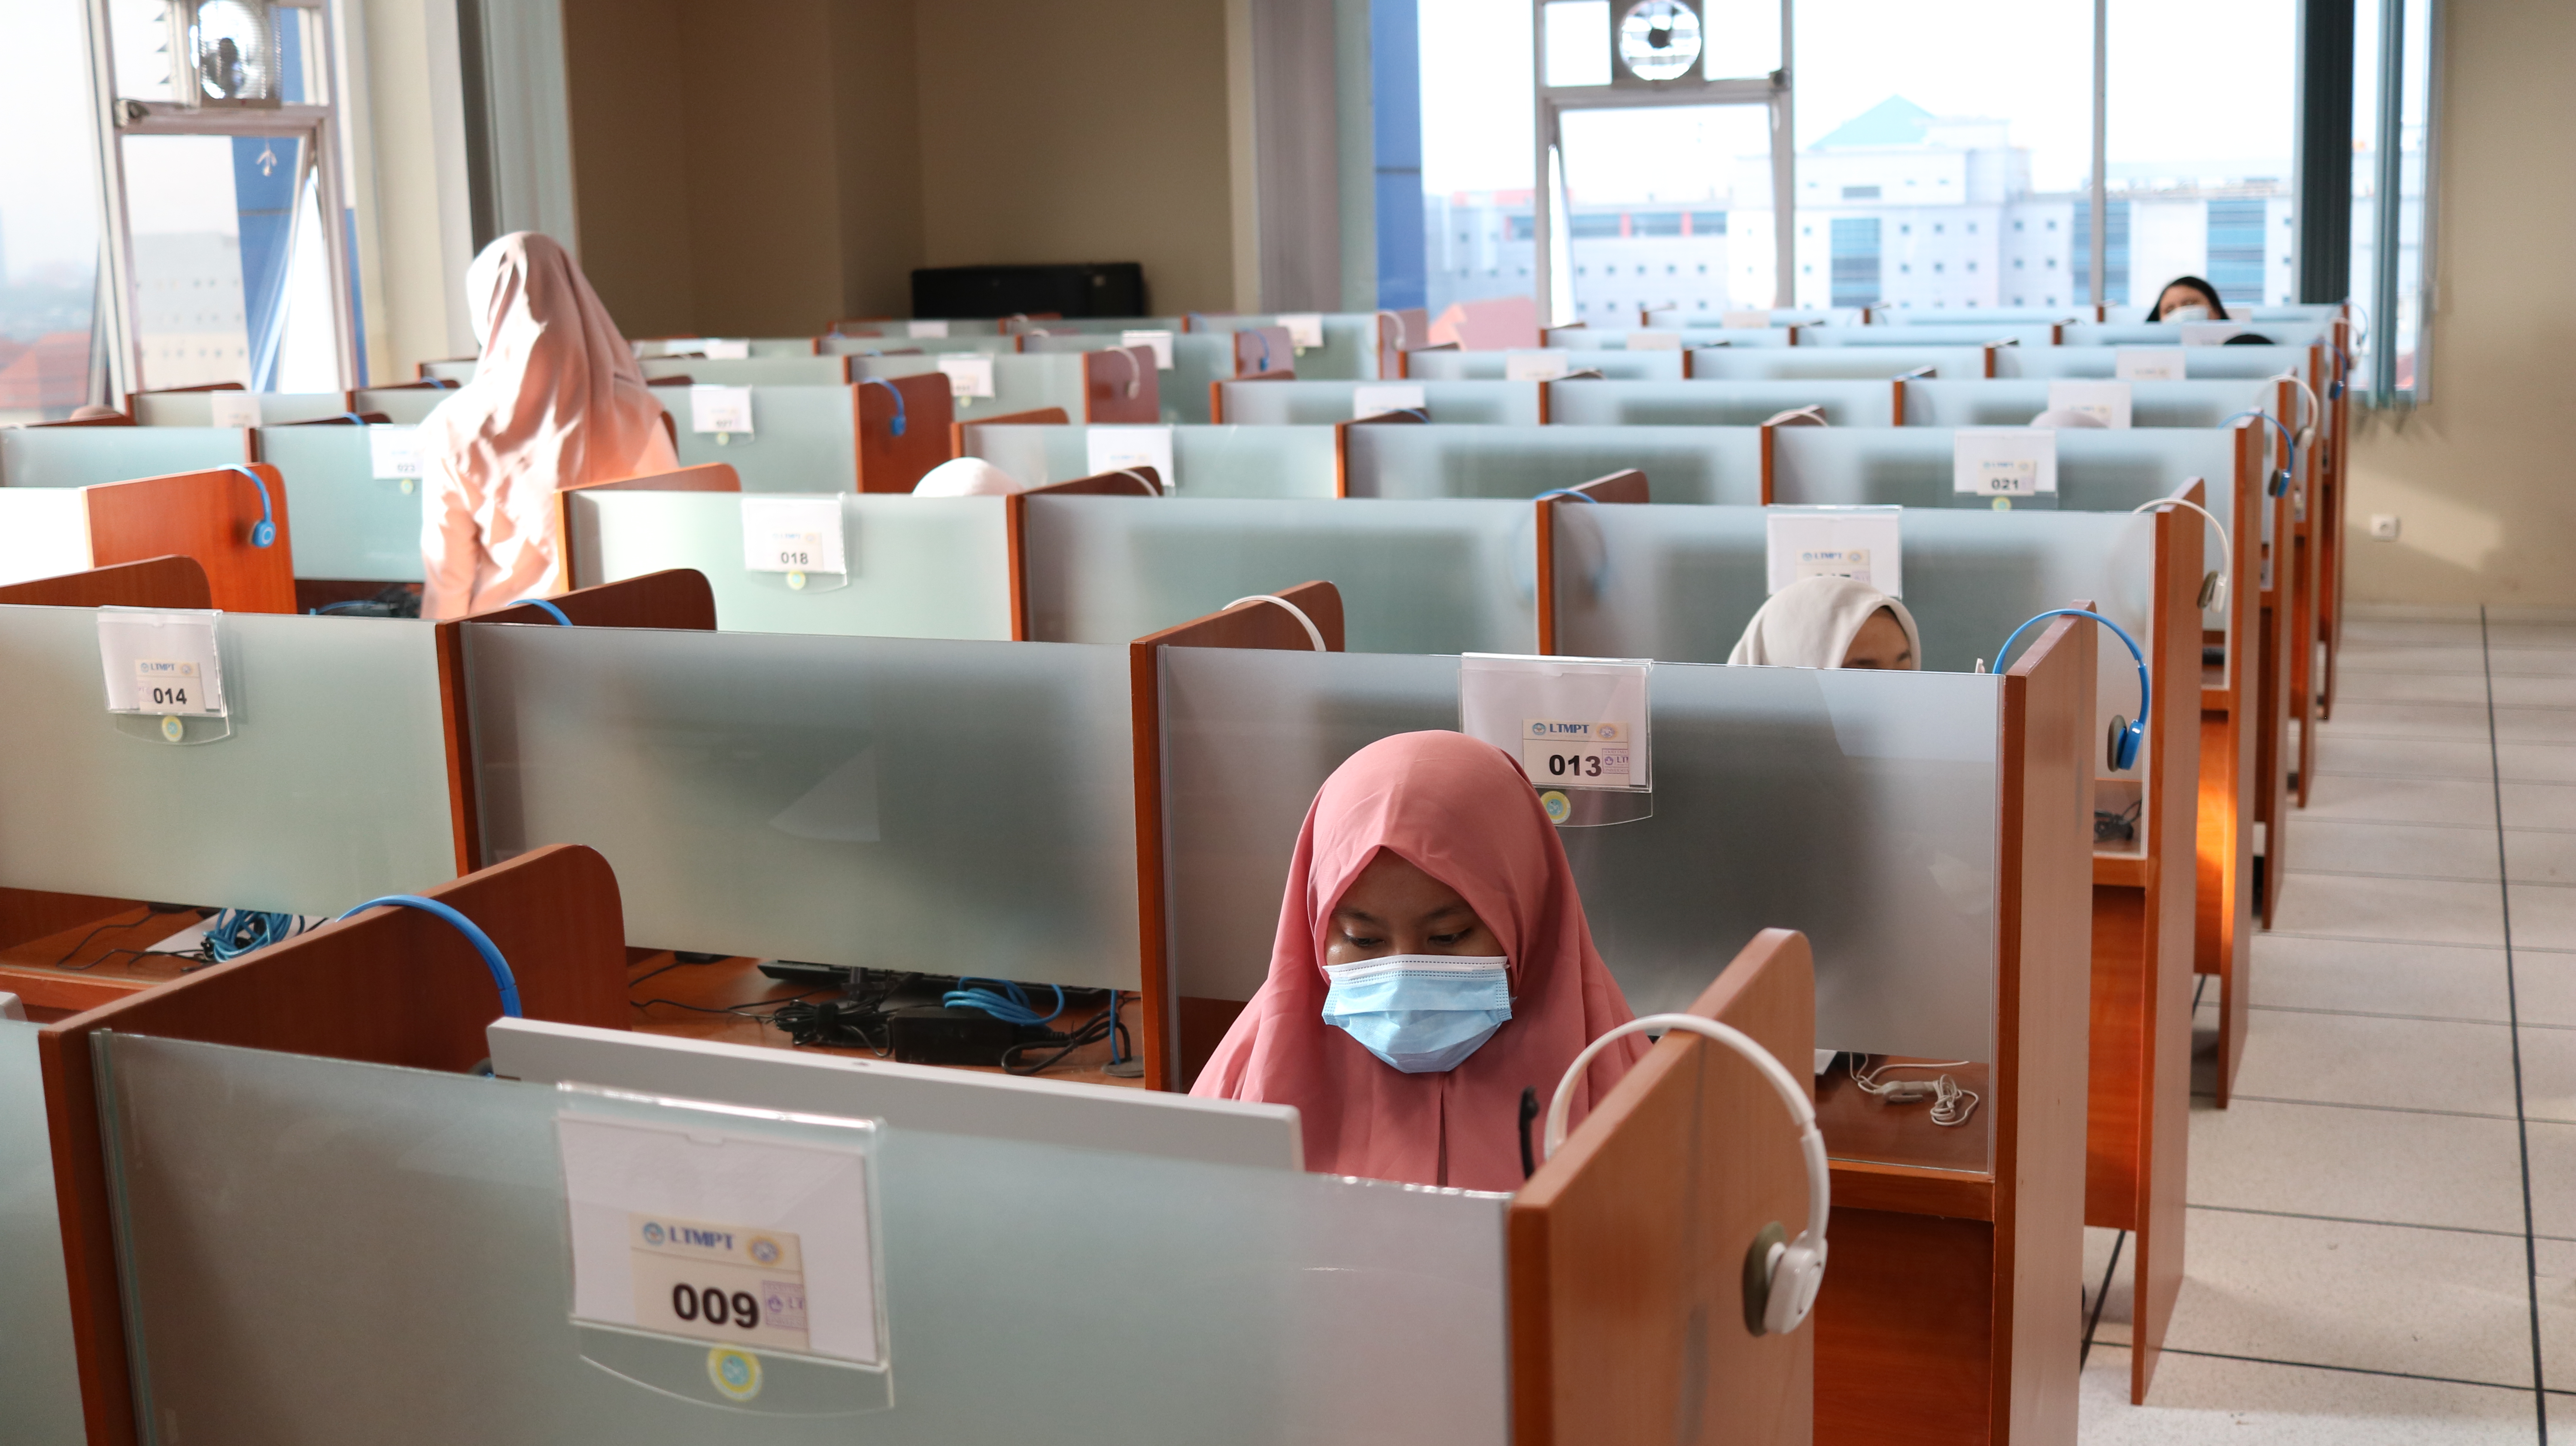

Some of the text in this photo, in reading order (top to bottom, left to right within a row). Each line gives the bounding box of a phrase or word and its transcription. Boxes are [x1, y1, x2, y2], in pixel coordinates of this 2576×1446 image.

[1991, 478, 2019, 490] 021
[781, 551, 808, 565] 018
[153, 688, 187, 705] 014
[1549, 723, 1589, 733] LTMPT
[1549, 754, 1602, 777] 013
[669, 1226, 734, 1250] LTMPT
[672, 1282, 760, 1329] 009
